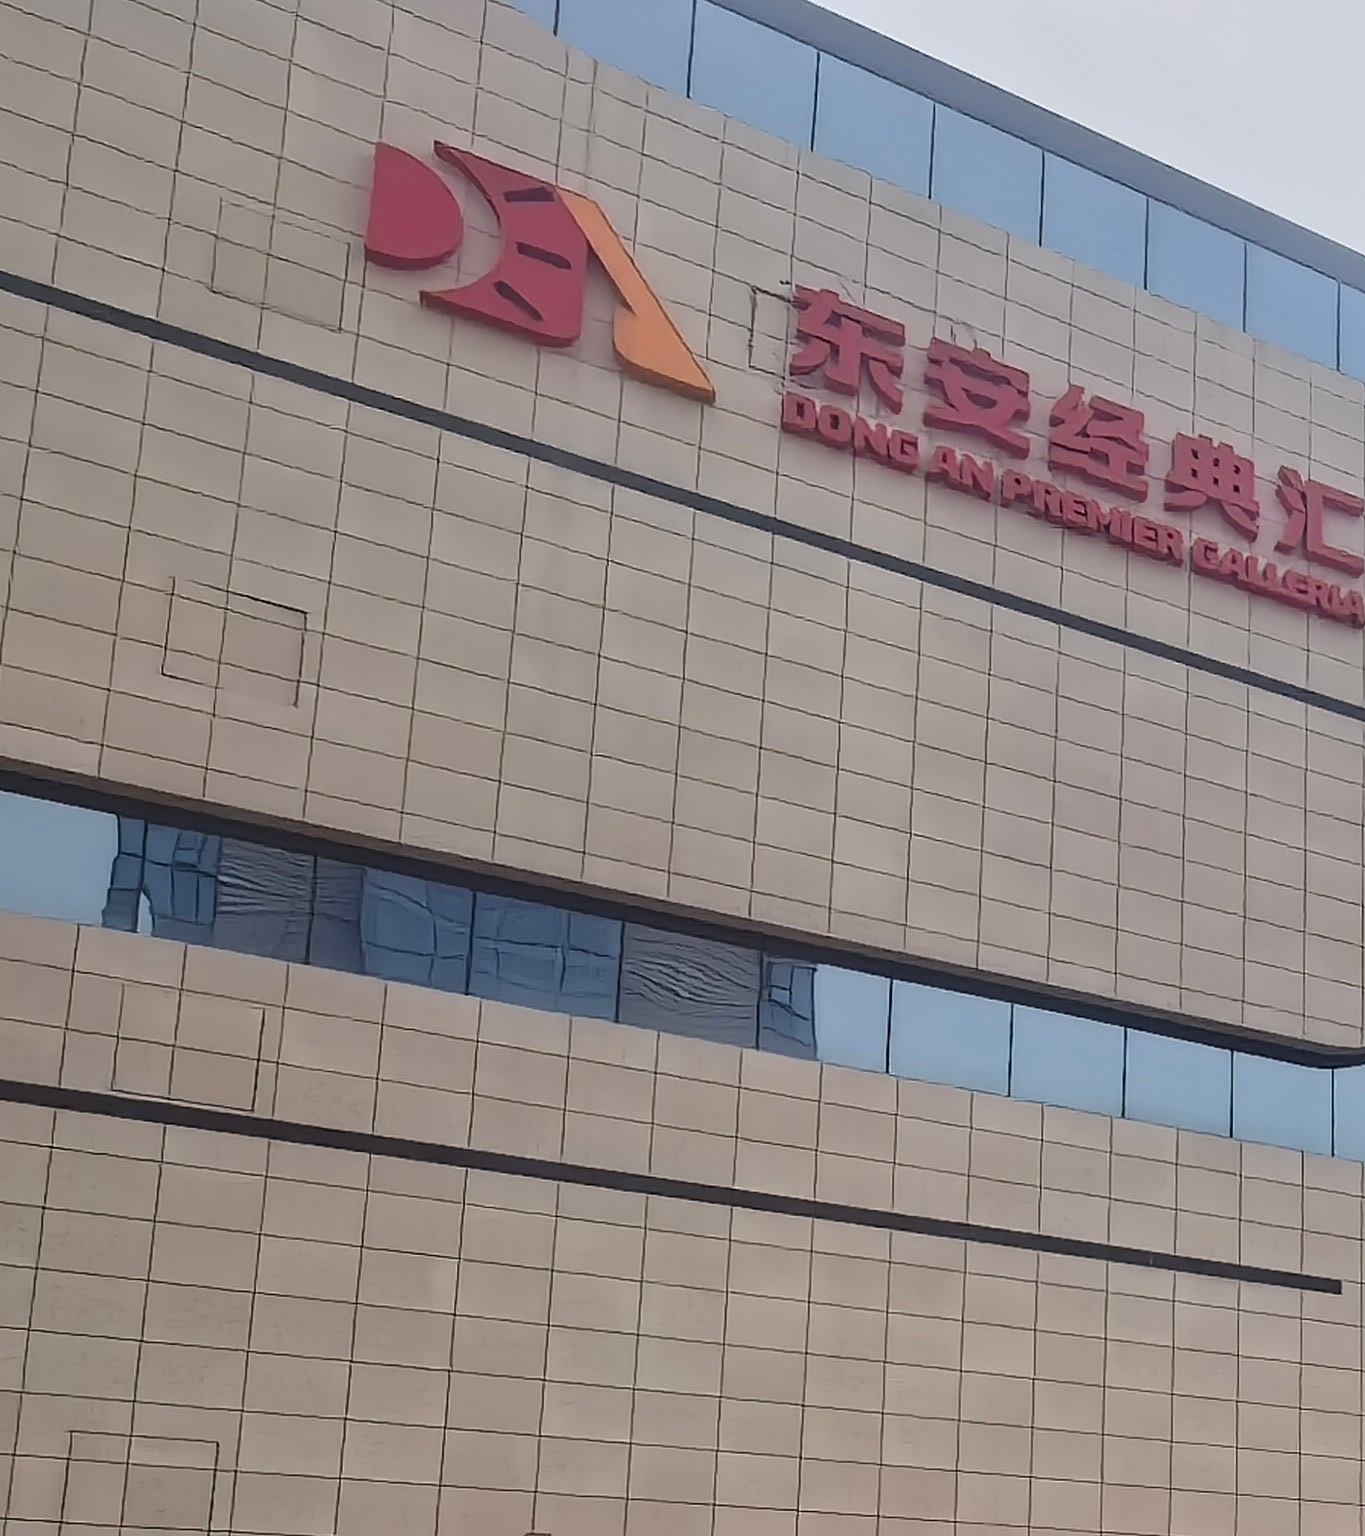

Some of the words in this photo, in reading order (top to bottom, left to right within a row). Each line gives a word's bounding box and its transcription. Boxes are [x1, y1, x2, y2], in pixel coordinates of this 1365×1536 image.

[780, 392, 919, 473] DONG
[925, 445, 995, 502] AN
[1000, 468, 1184, 567] PREMIER
[1191, 536, 1365, 629] GALLERIA
[789, 284, 1365, 577] 东安经典汇
